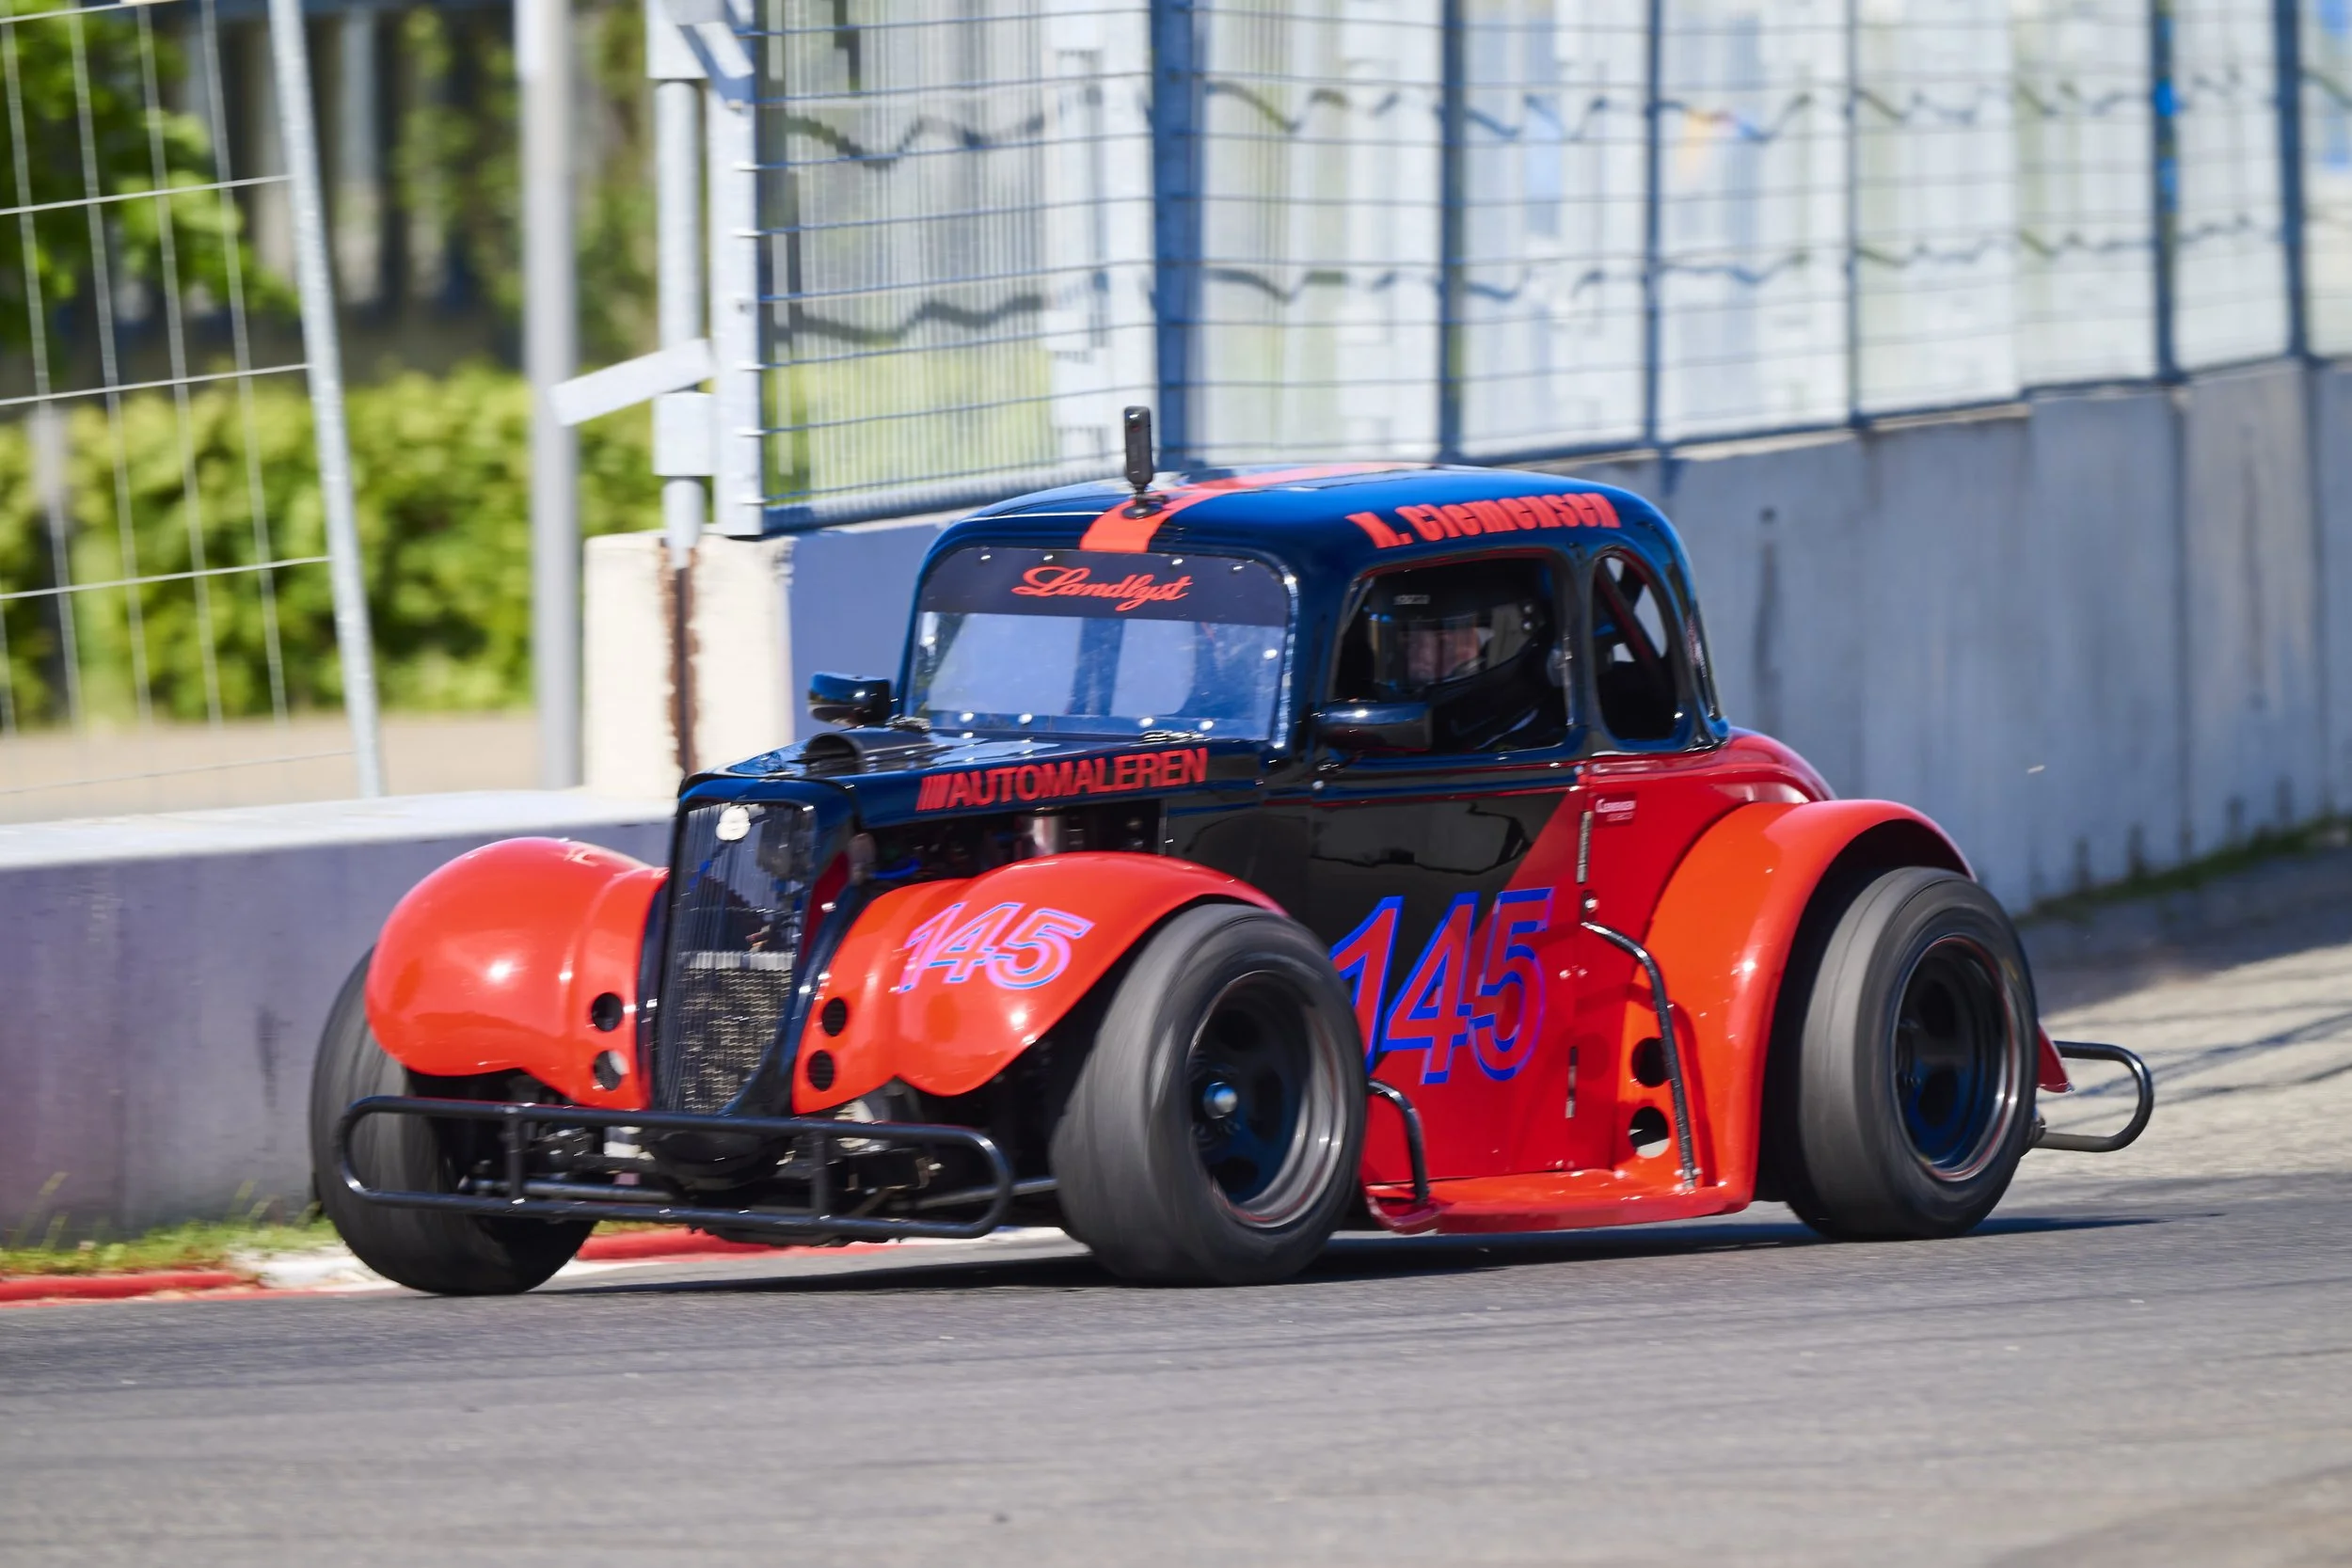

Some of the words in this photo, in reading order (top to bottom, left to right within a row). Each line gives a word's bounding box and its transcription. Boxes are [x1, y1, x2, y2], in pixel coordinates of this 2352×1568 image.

[1010, 565, 1194, 611] Landlyst
[898, 900, 1096, 994] 145
[1328, 886, 1556, 1085] 145
